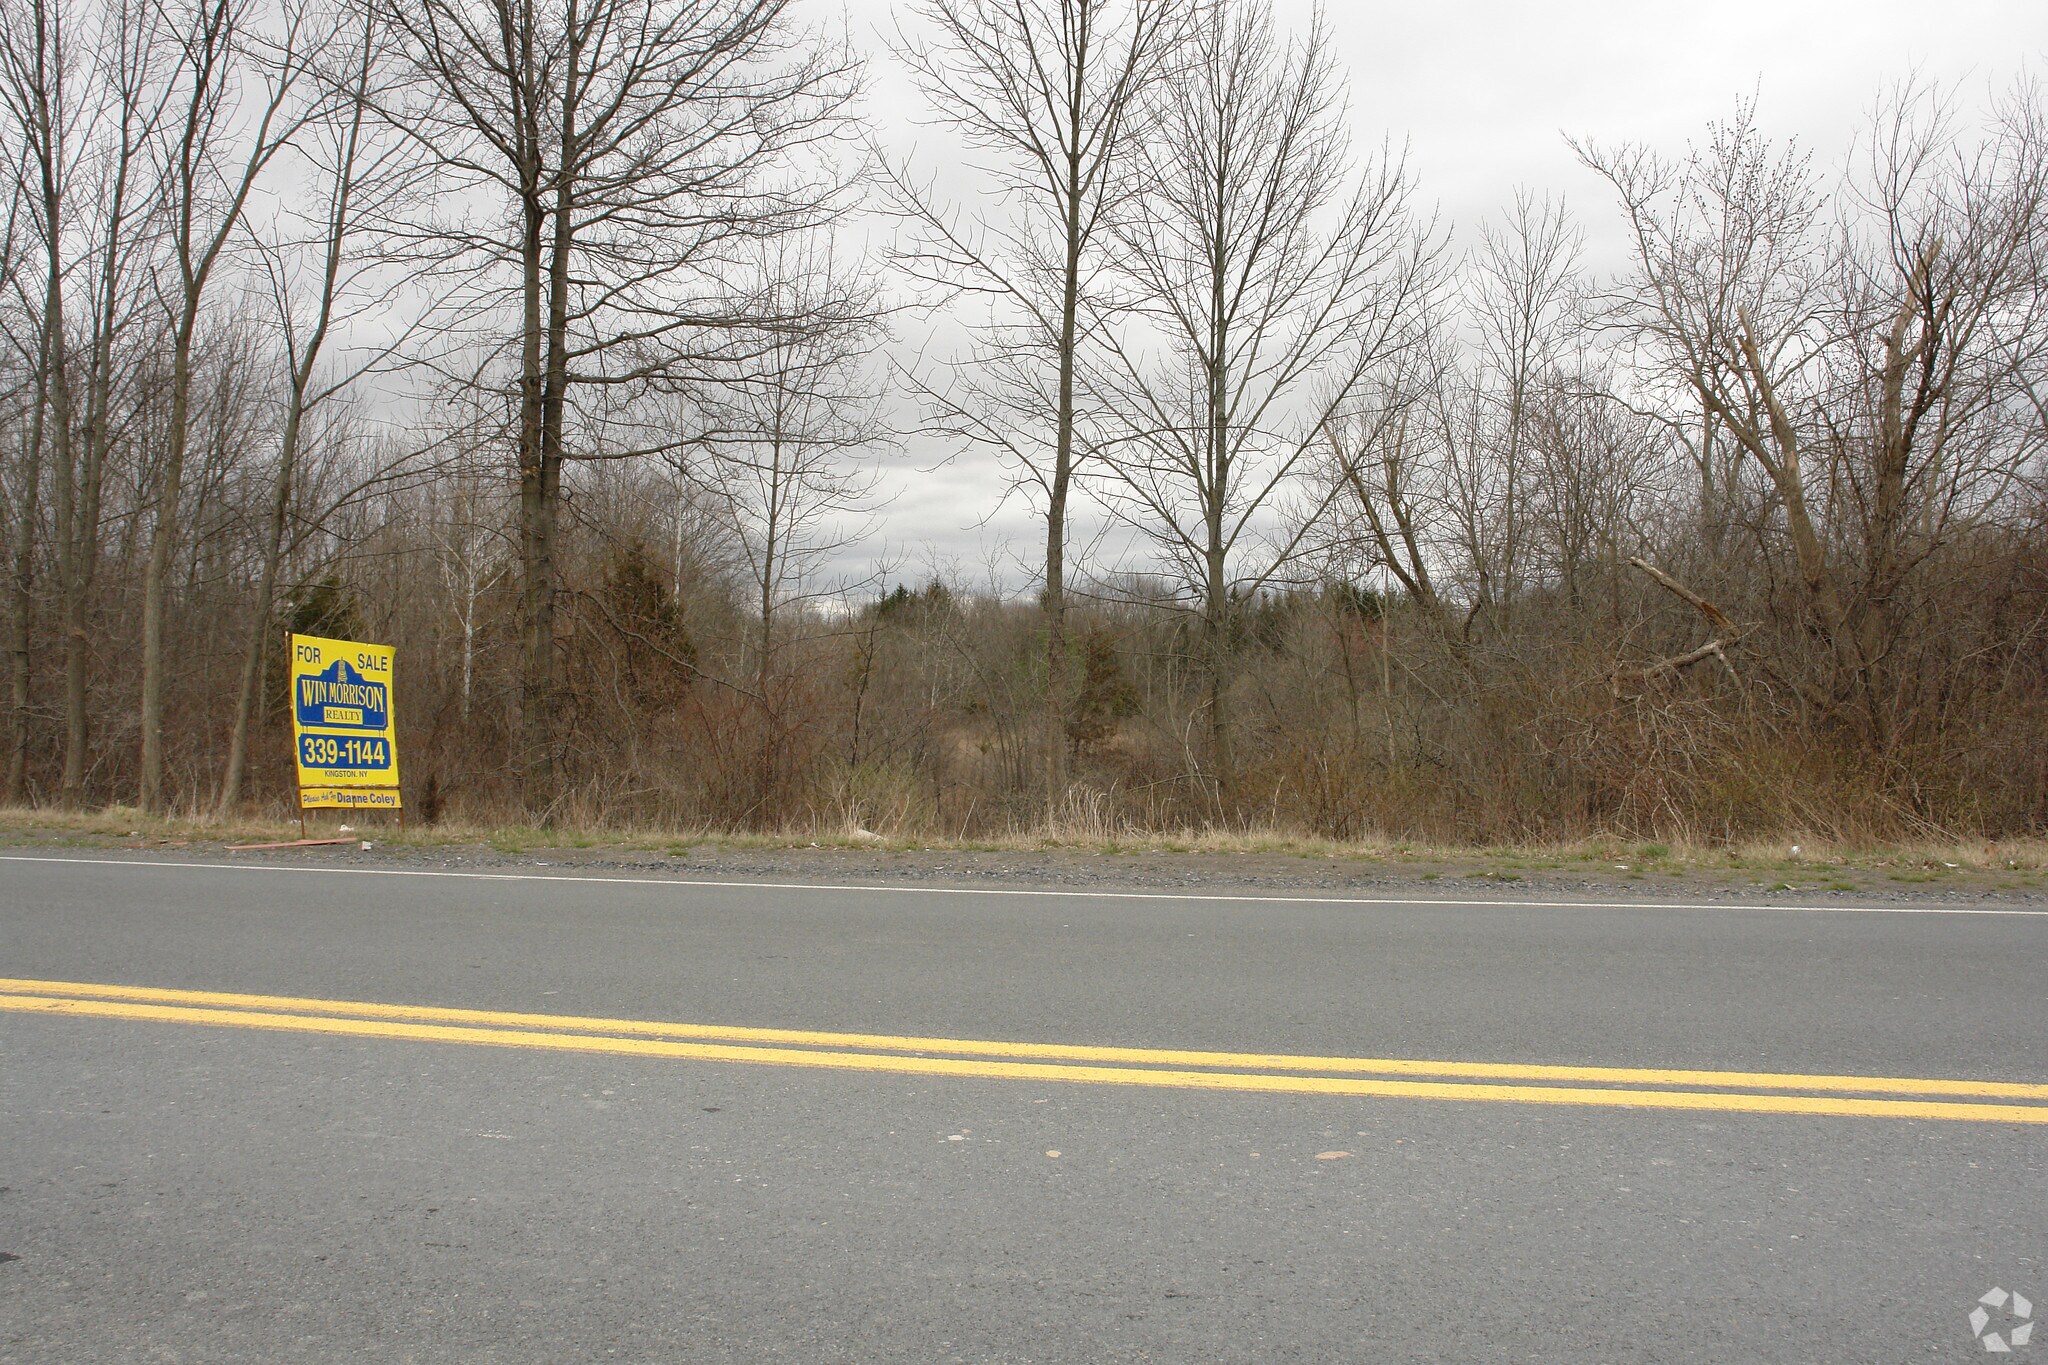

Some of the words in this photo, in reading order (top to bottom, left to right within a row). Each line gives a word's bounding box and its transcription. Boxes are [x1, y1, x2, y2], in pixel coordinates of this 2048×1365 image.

[297, 645, 321, 664] FOR
[357, 653, 388, 671] SALE
[301, 679, 327, 707] WIN
[328, 682, 384, 712] MORRISON
[325, 709, 361, 721] REALTY
[304, 737, 385, 765] 339-1144
[359, 770, 368, 778] NY
[337, 792, 368, 803] Dianne
[369, 793, 396, 806] Coley
